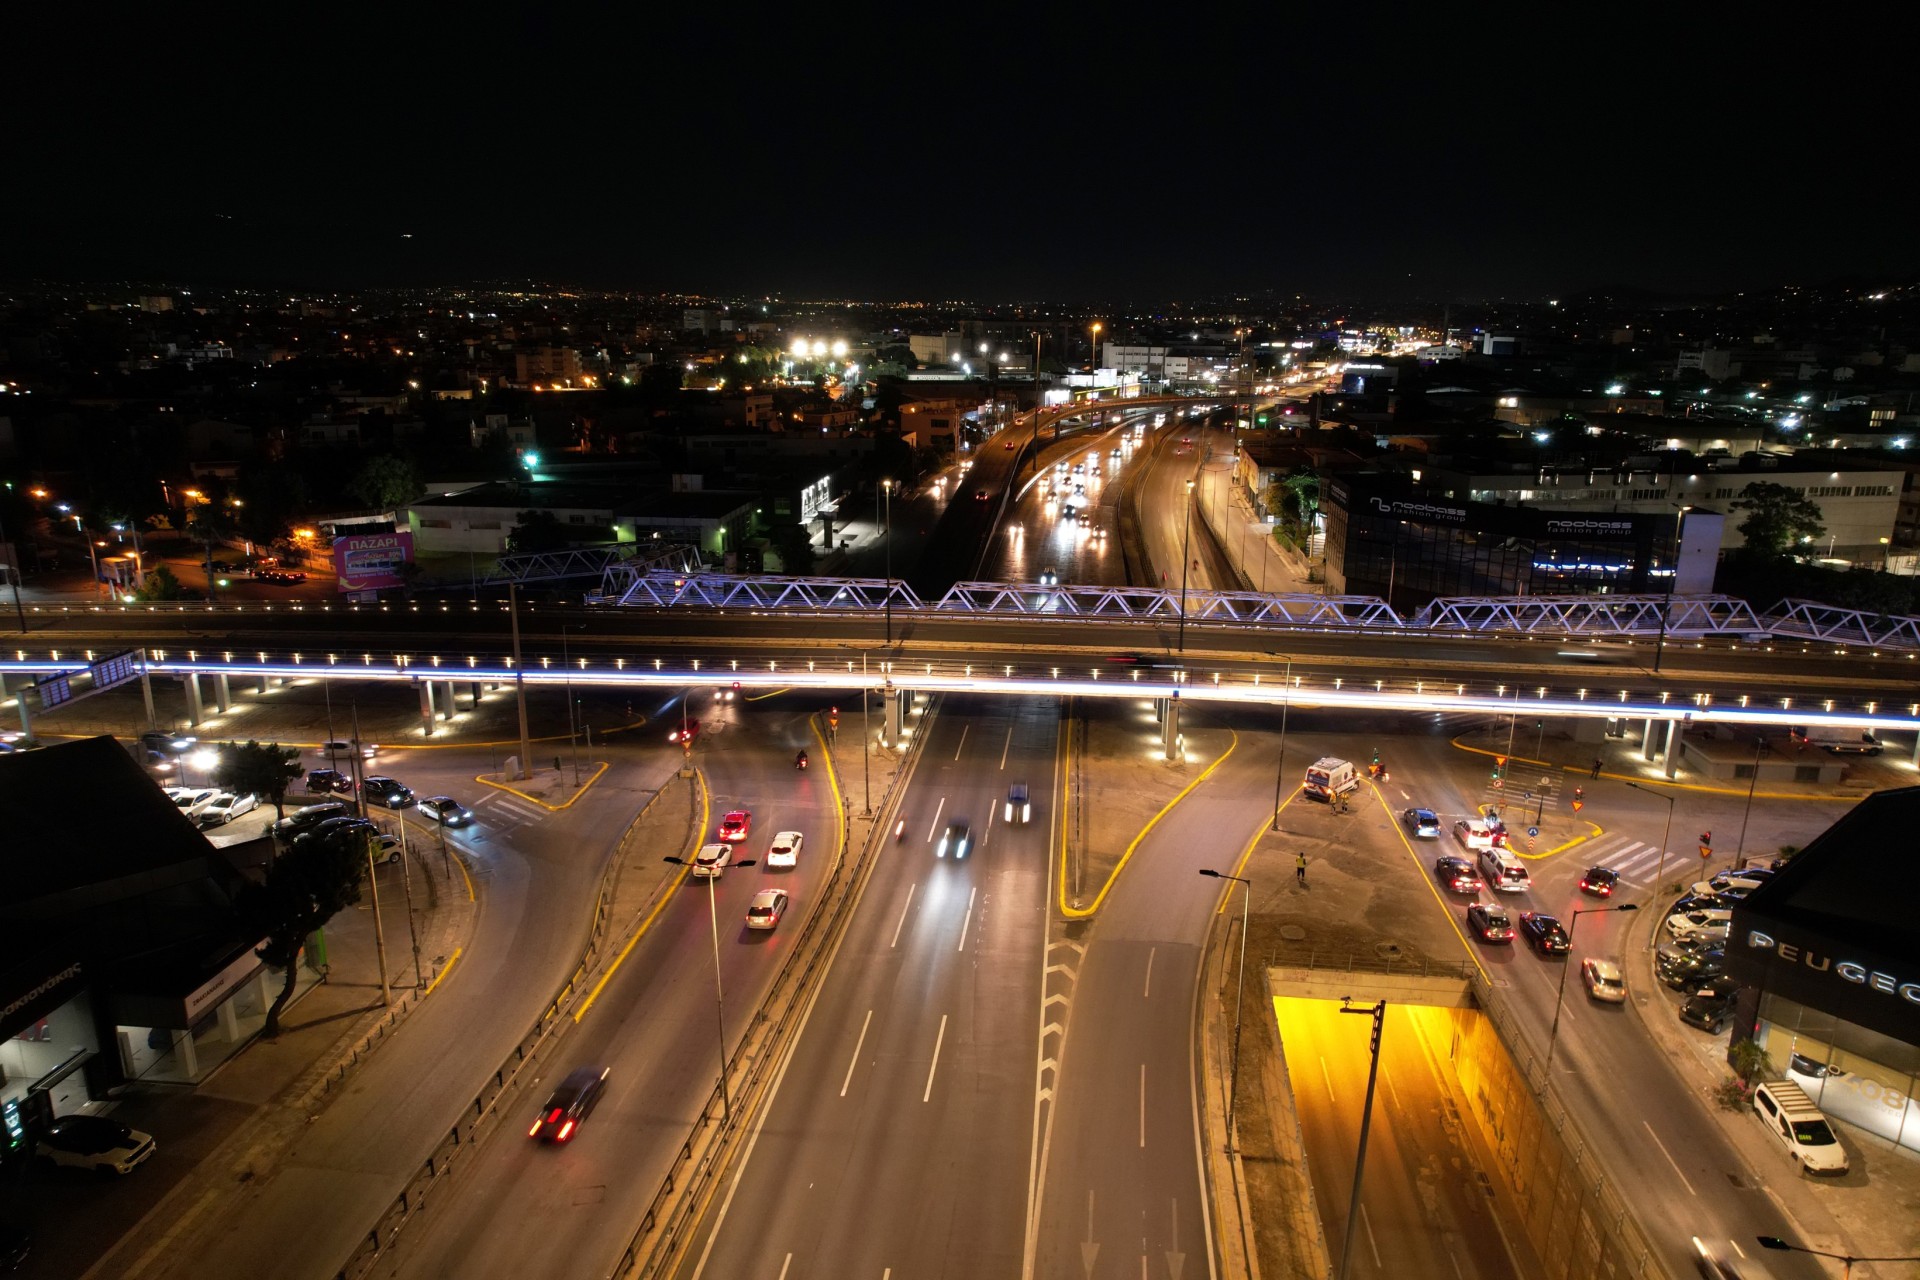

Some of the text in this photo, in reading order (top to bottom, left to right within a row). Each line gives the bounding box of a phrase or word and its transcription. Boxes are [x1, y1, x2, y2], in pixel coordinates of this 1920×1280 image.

[1392, 501, 1466, 516] noobass
[1393, 507, 1466, 522] fashion group
[1547, 520, 1632, 529] noobass
[1547, 526, 1632, 536] fashion group
[349, 537, 398, 550] ΠΑΖΑΡΙ
